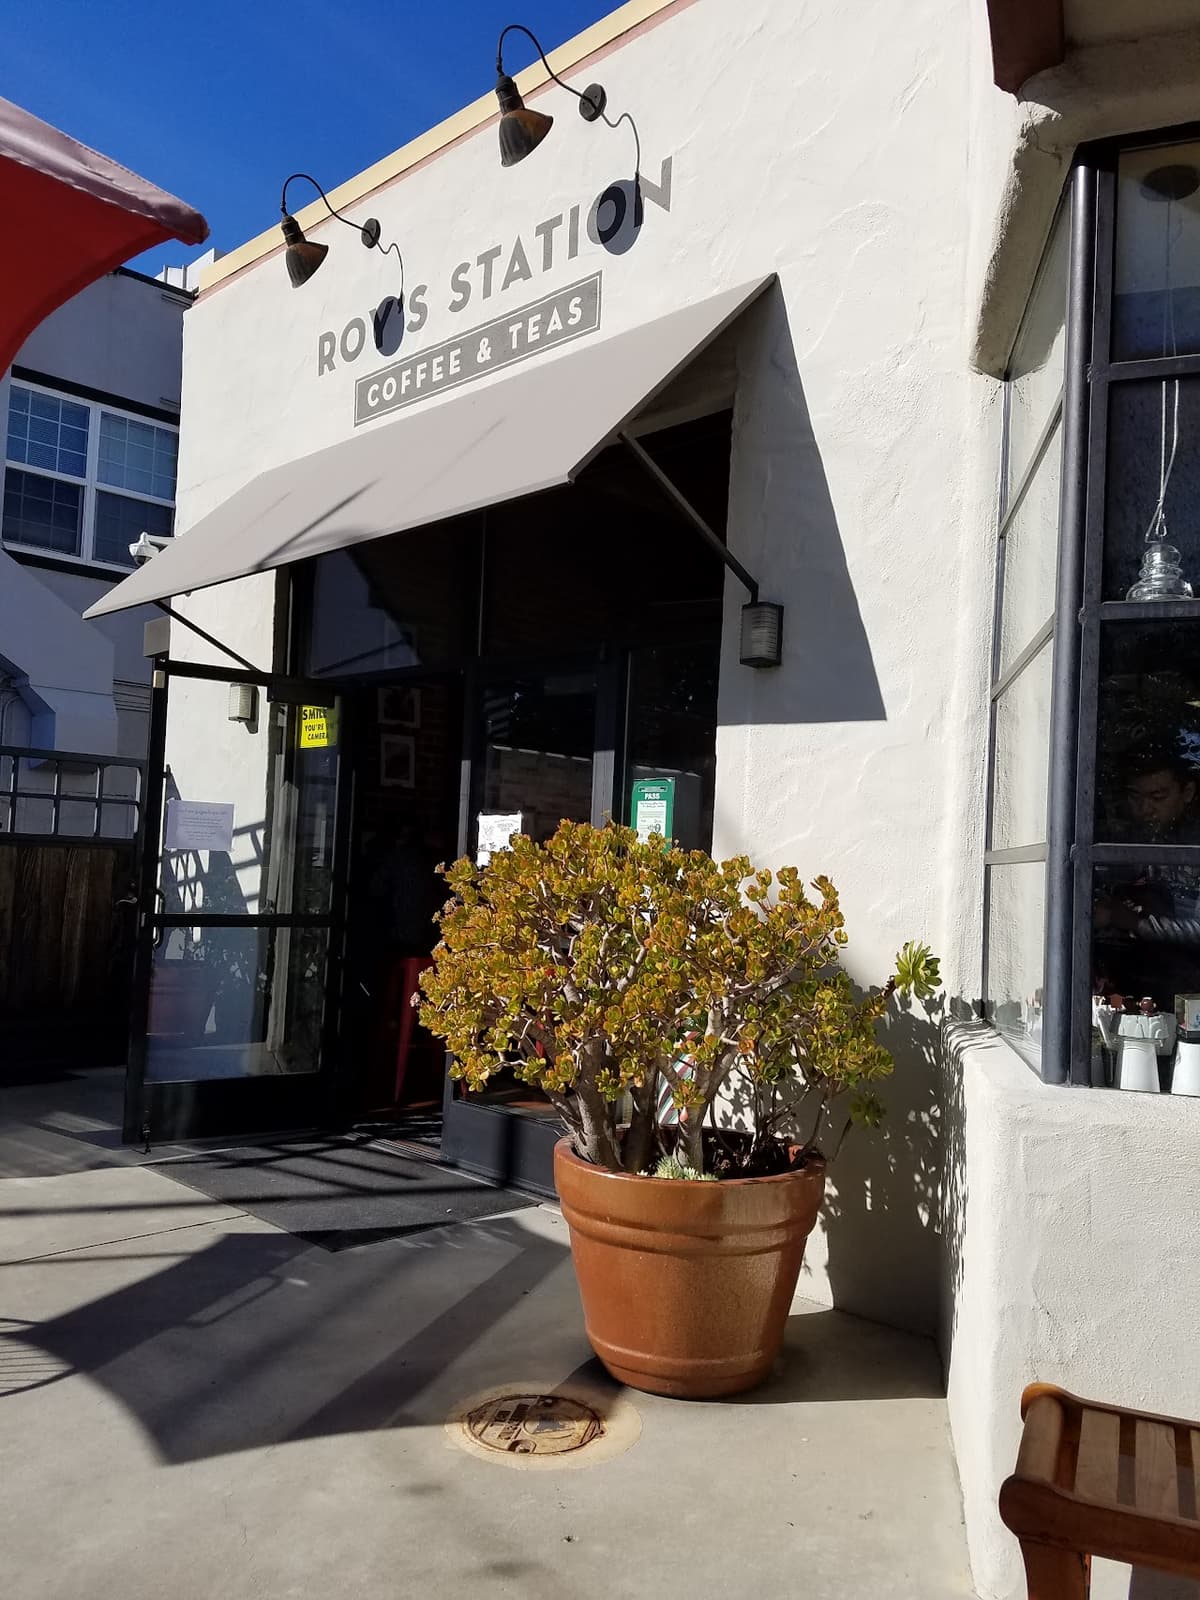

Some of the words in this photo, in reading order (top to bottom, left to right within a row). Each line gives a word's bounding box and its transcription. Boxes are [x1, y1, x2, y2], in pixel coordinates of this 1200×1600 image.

[318, 284, 428, 376] ROY'S
[448, 155, 673, 313] STATION
[367, 348, 461, 407] COFFEE
[476, 336, 492, 363] &
[508, 296, 583, 350] TEAS
[303, 709, 328, 720] SMILE
[644, 792, 660, 800] PASS
